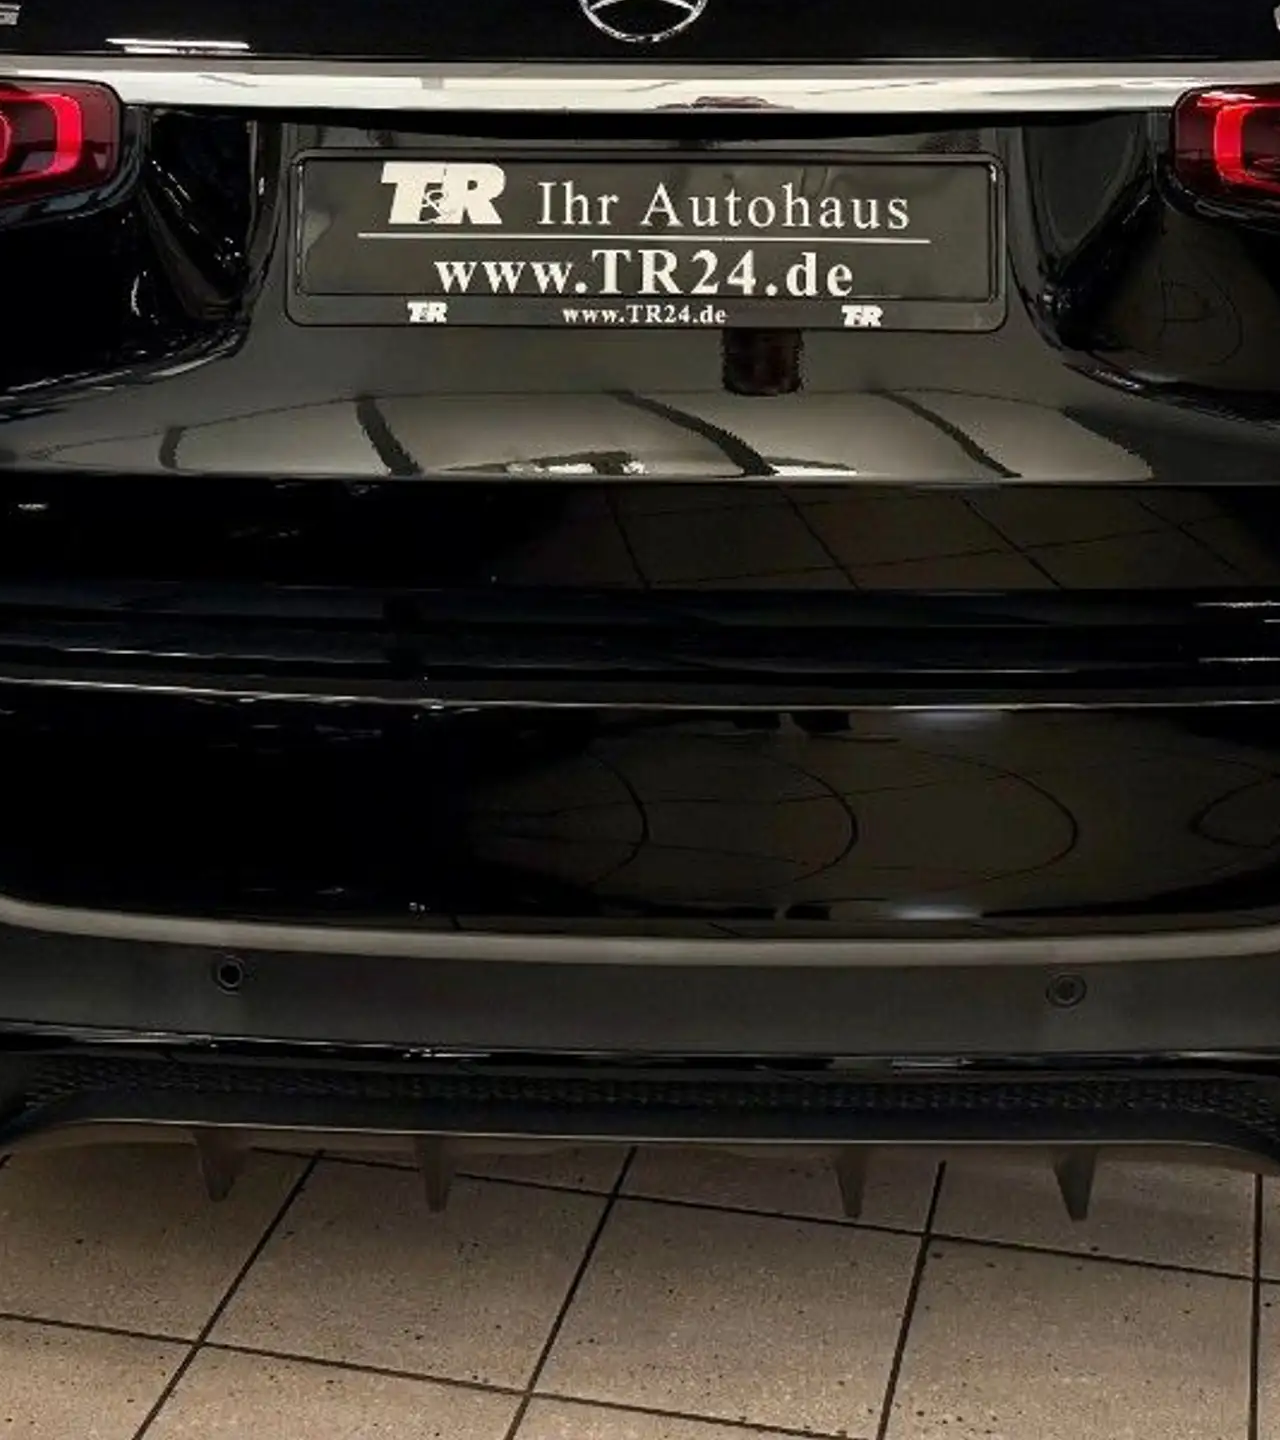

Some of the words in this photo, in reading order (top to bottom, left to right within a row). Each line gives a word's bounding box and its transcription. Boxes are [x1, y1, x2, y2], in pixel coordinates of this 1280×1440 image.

[536, 182, 619, 226] Ihr
[640, 182, 910, 229] Autohaus
[434, 249, 854, 298] www.TR24.de
[562, 304, 728, 324] www.TR24.de
